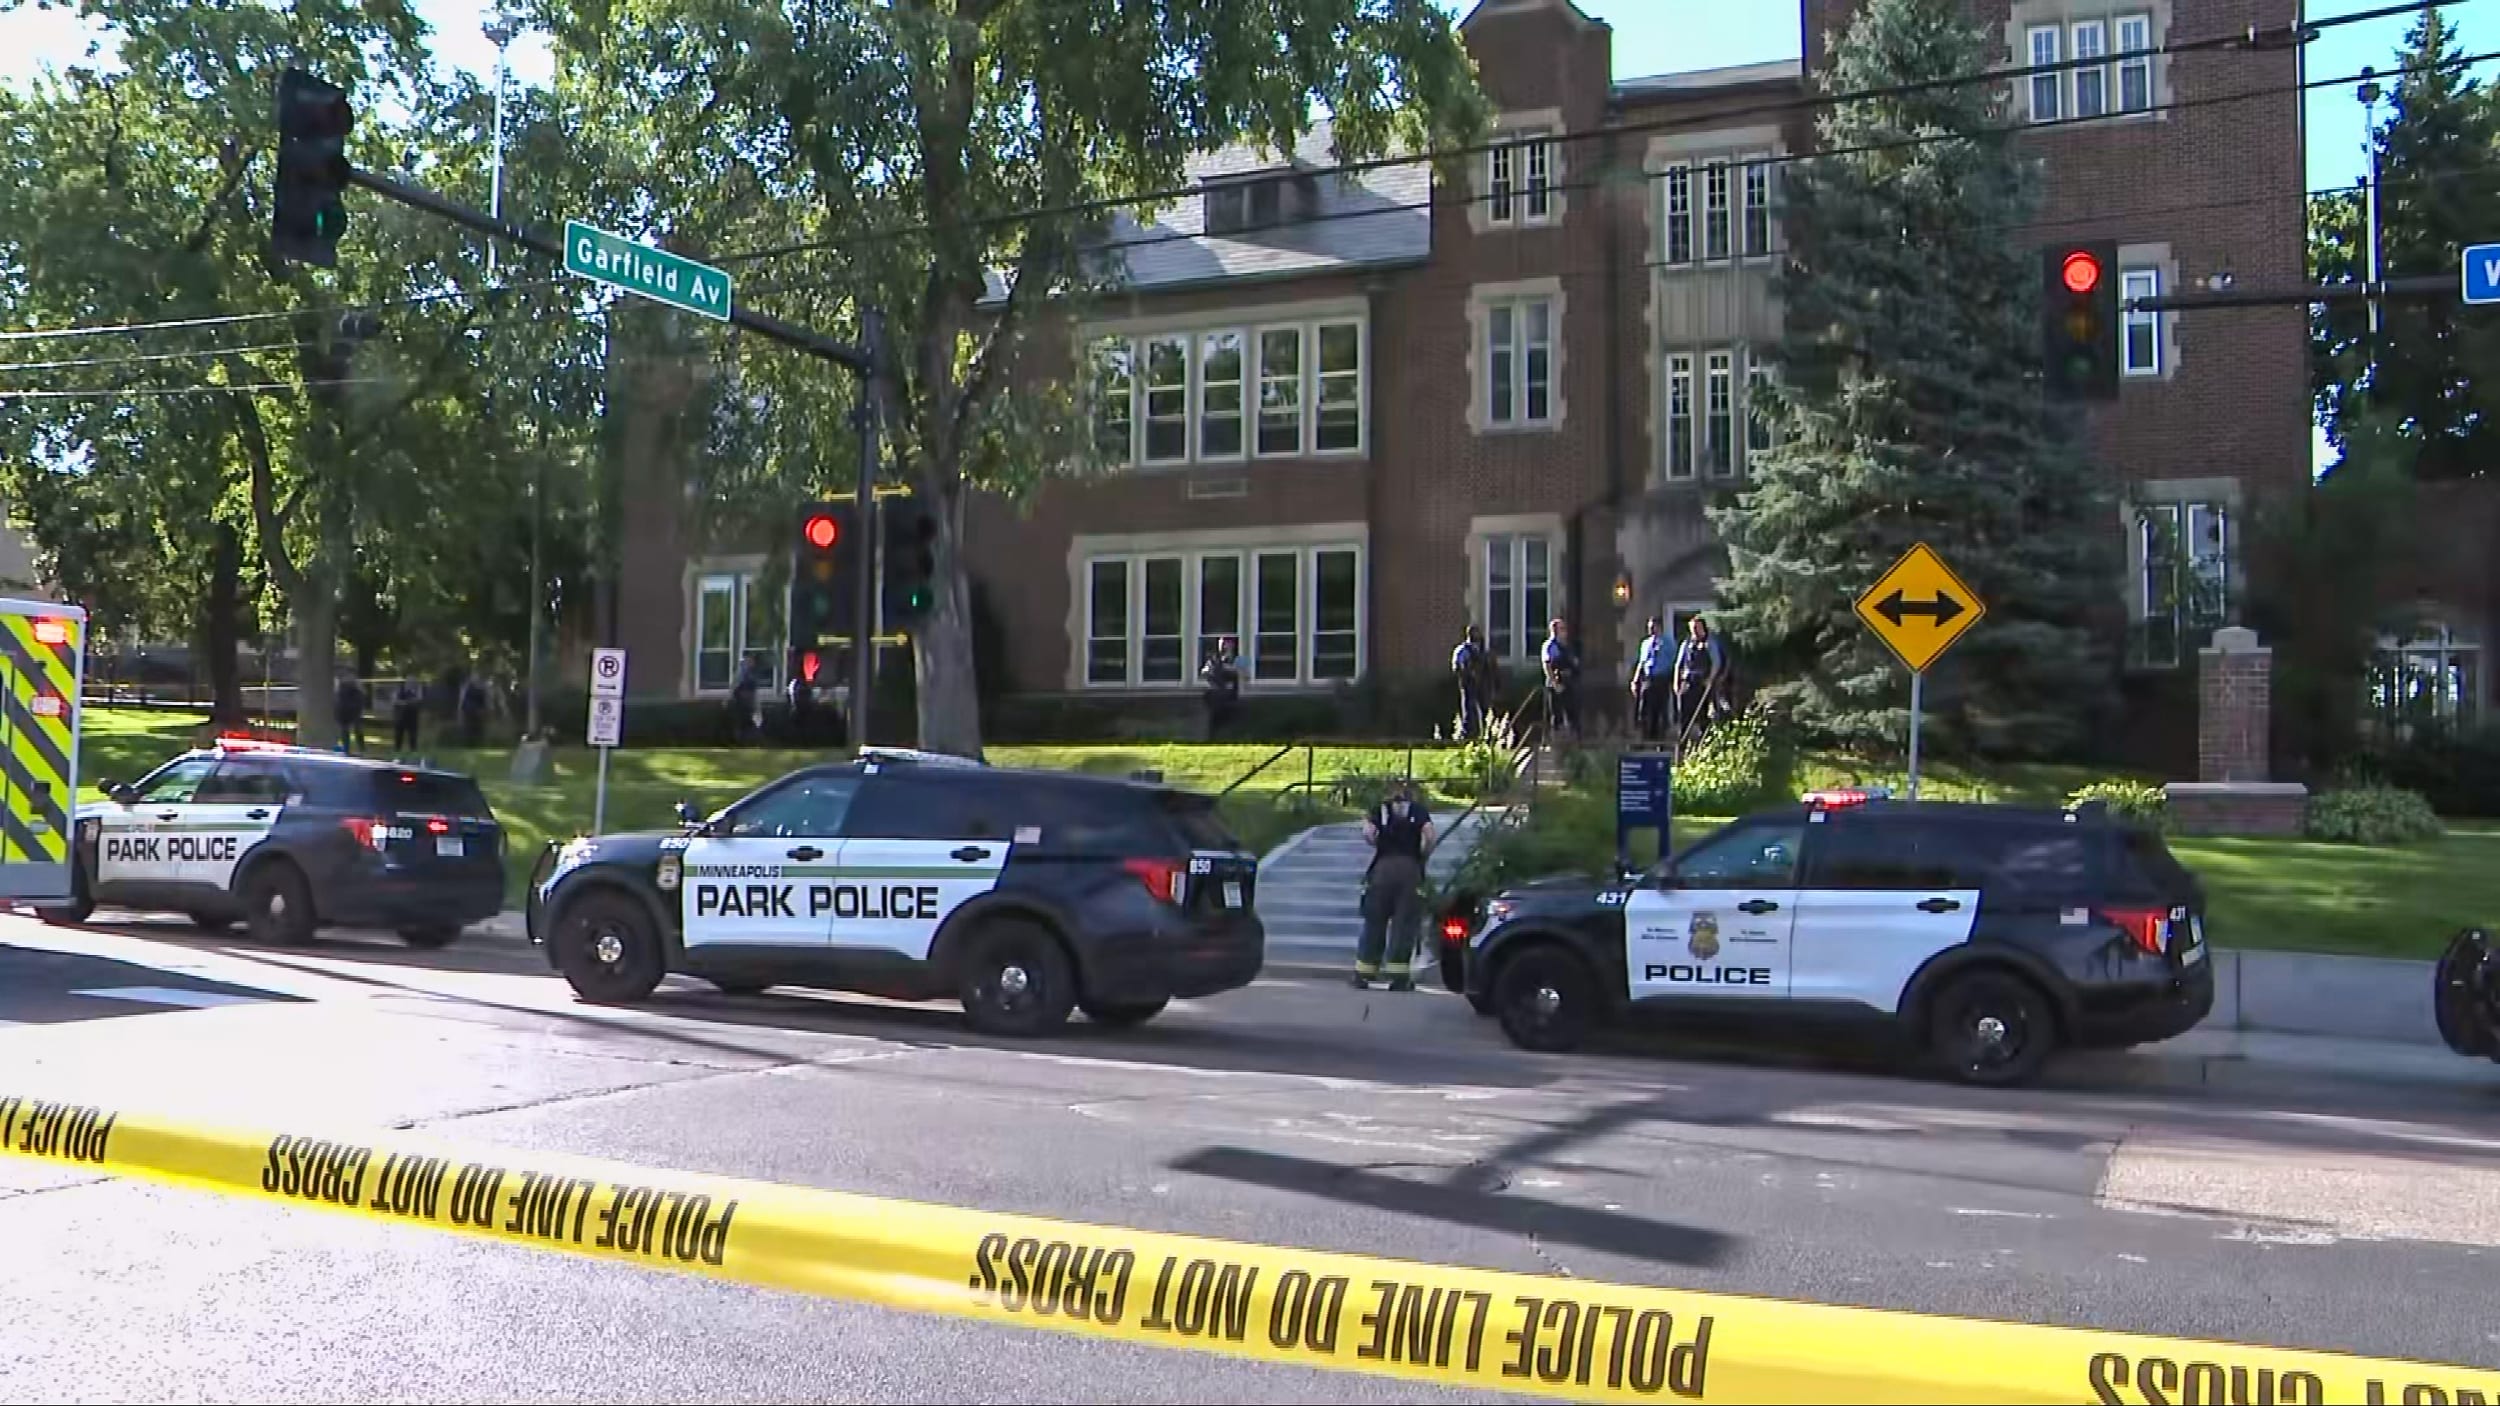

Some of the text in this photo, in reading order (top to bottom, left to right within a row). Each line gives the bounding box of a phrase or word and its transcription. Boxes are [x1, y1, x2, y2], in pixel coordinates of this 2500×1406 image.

[577, 238, 720, 305] Garfield Av
[107, 837, 237, 861] PARK POLICE
[700, 866, 780, 878] MINNEAPOLIS
[697, 884, 939, 919] PARK POLICE
[1596, 892, 1626, 905] 431
[1645, 965, 1770, 985] POLICE
[19, 1098, 118, 1164] POLICE
[261, 1133, 738, 1265] POLICE LINE DO NOT CROSS
[969, 1232, 1714, 1400] POLICE LINE DO NOT CROSS
